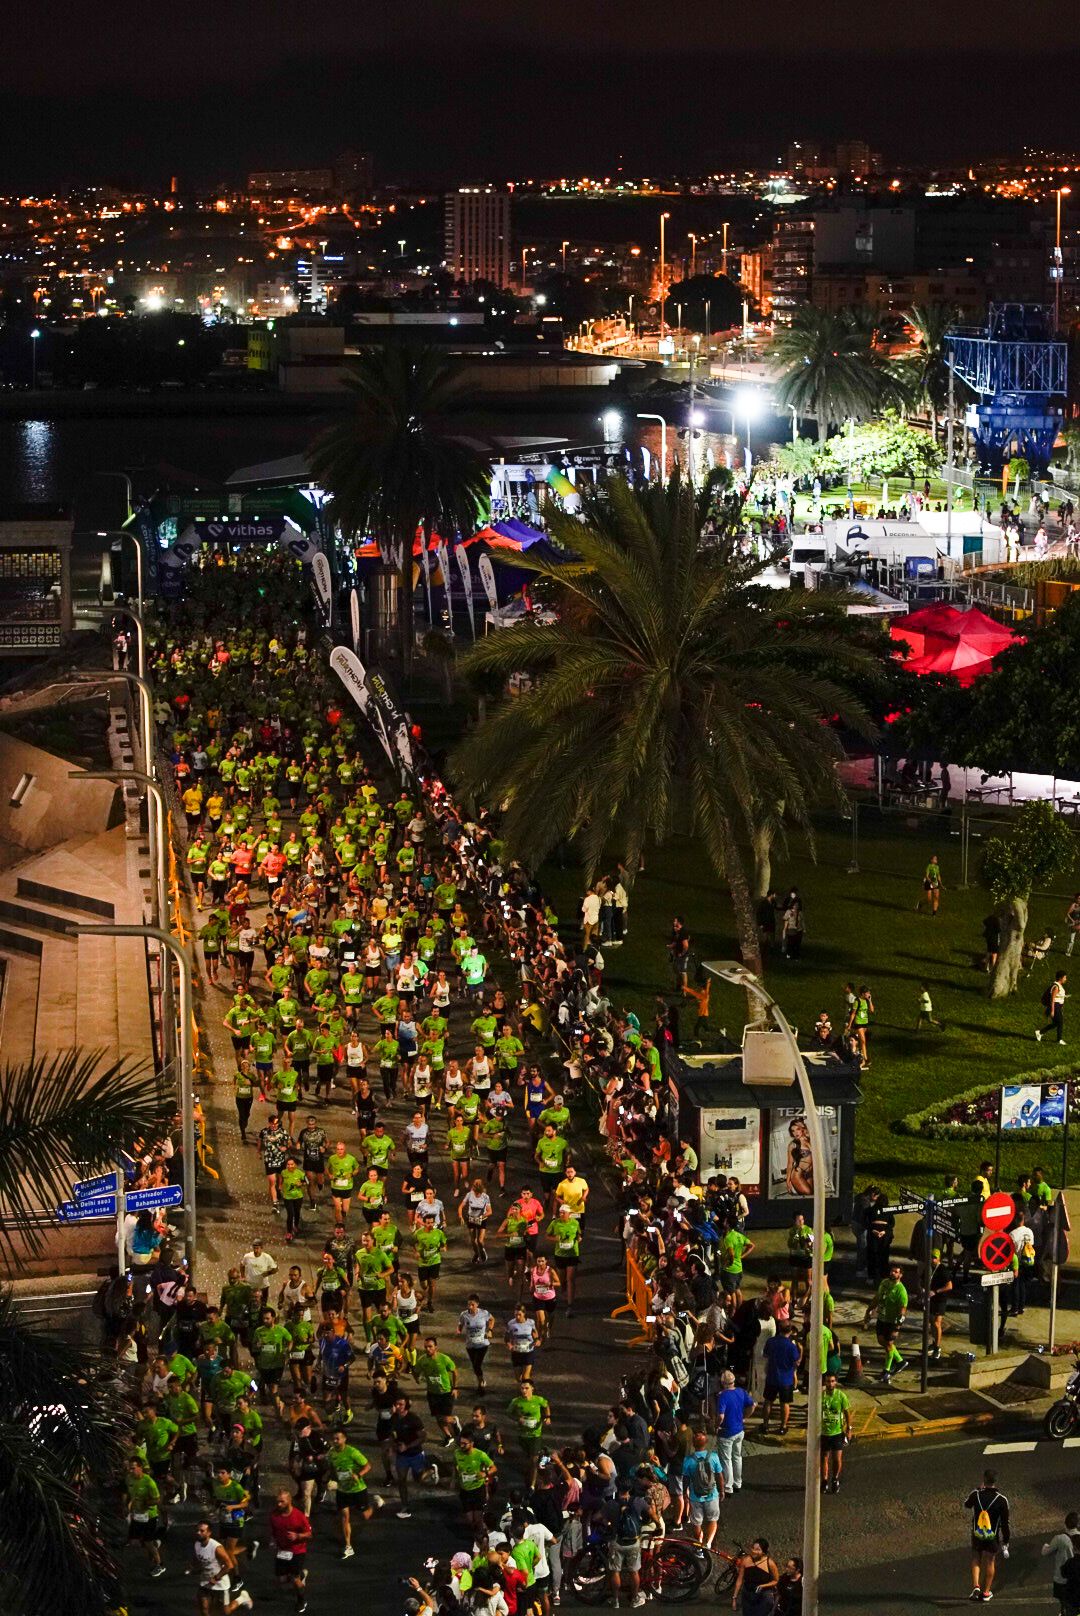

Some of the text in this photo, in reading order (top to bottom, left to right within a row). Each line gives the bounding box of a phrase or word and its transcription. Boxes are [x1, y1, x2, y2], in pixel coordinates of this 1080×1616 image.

[228, 524, 273, 536] vithas
[138, 1191, 163, 1199] Salvador
[80, 1200, 96, 1208] Delhi
[135, 1199, 161, 1208] Bahamas
